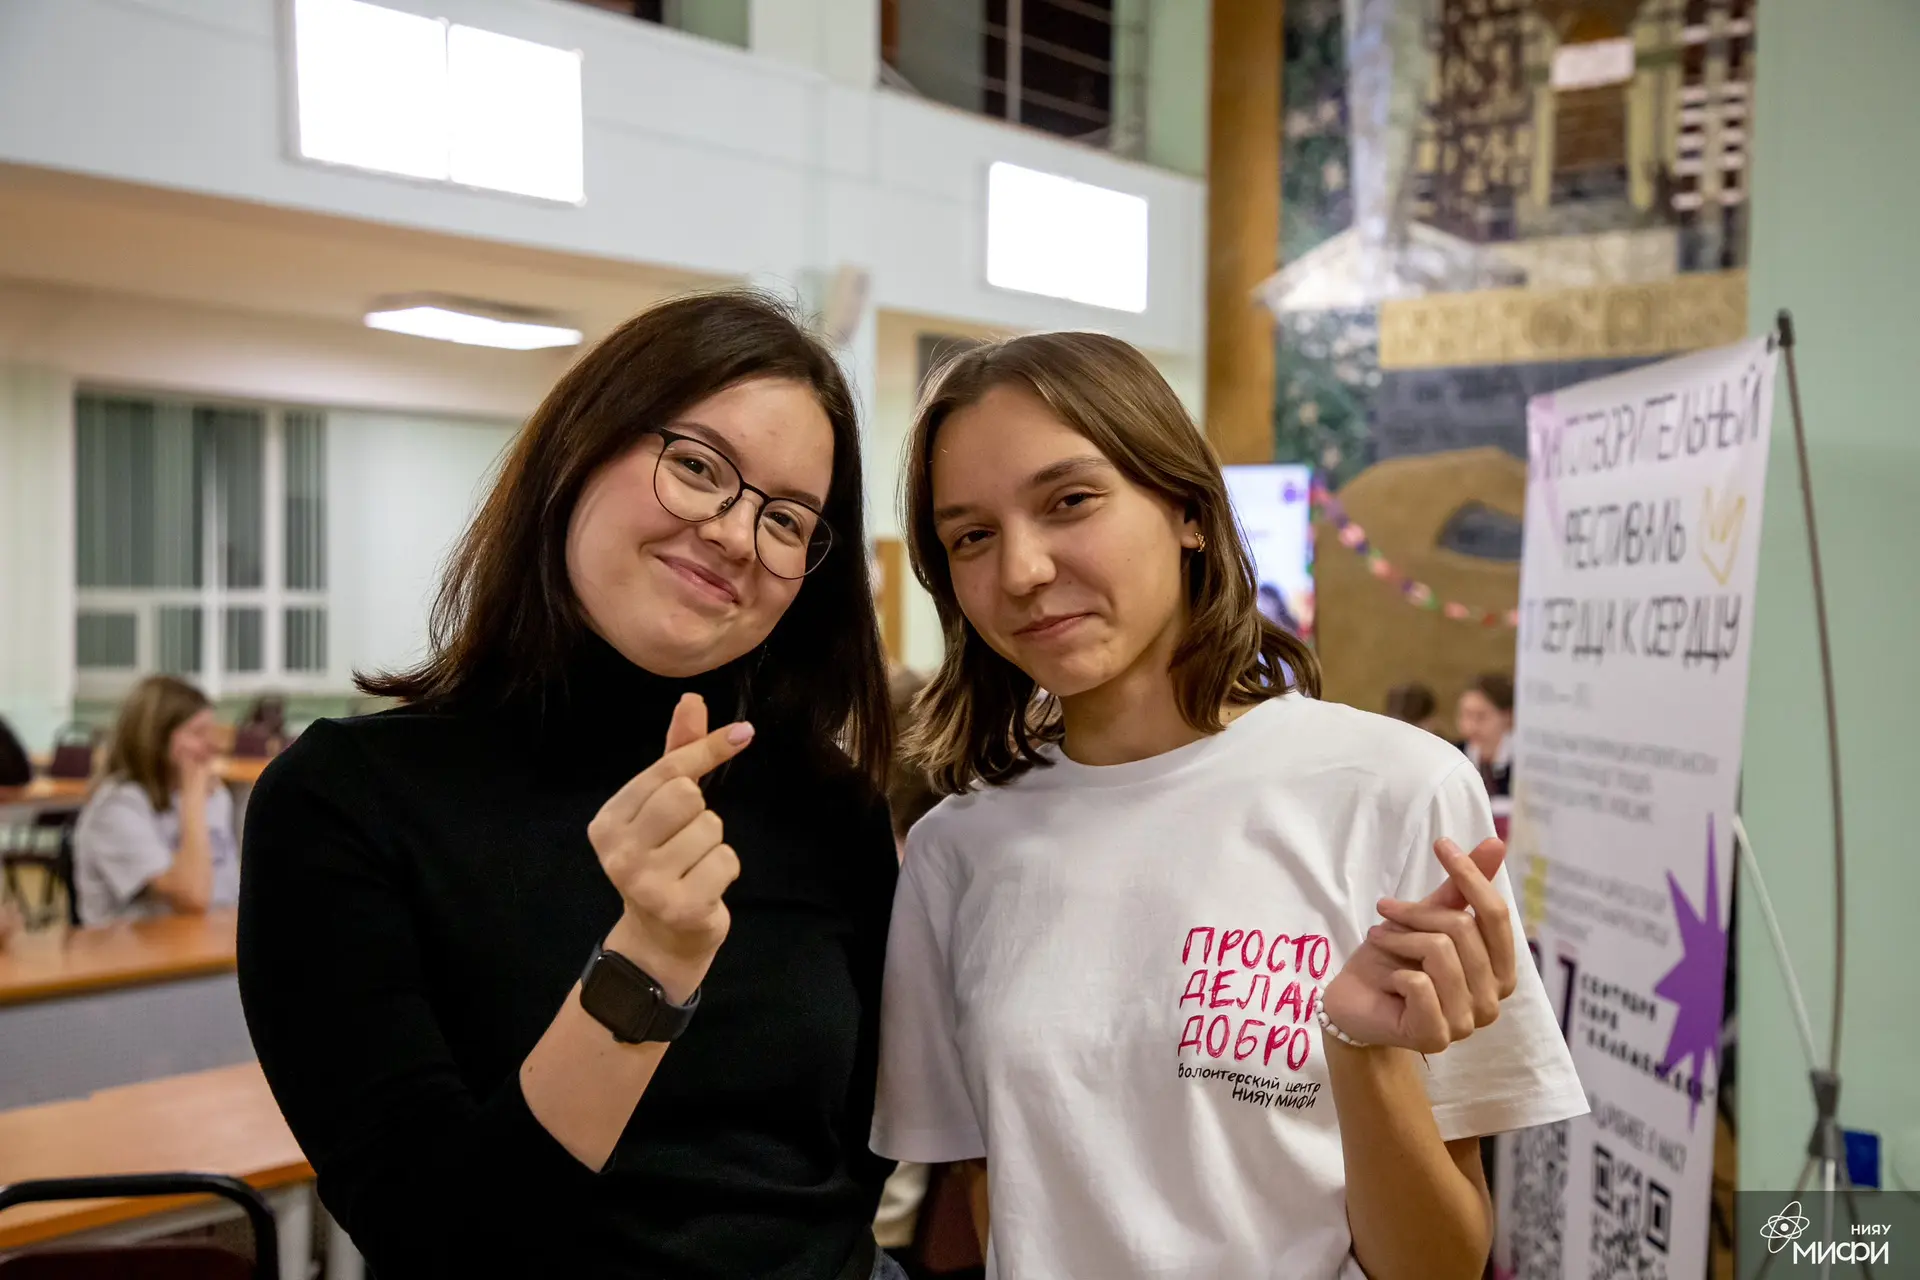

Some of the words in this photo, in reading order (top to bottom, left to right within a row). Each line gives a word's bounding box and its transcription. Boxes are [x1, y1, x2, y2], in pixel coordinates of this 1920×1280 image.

[1182, 926, 1331, 980] ПРОСТО
[1178, 1014, 1310, 1071] ДОБРО
[1232, 1086, 1274, 1108] НИЯУ
[1274, 1094, 1316, 1109] МИФИ
[1285, 1081, 1321, 1099] центр
